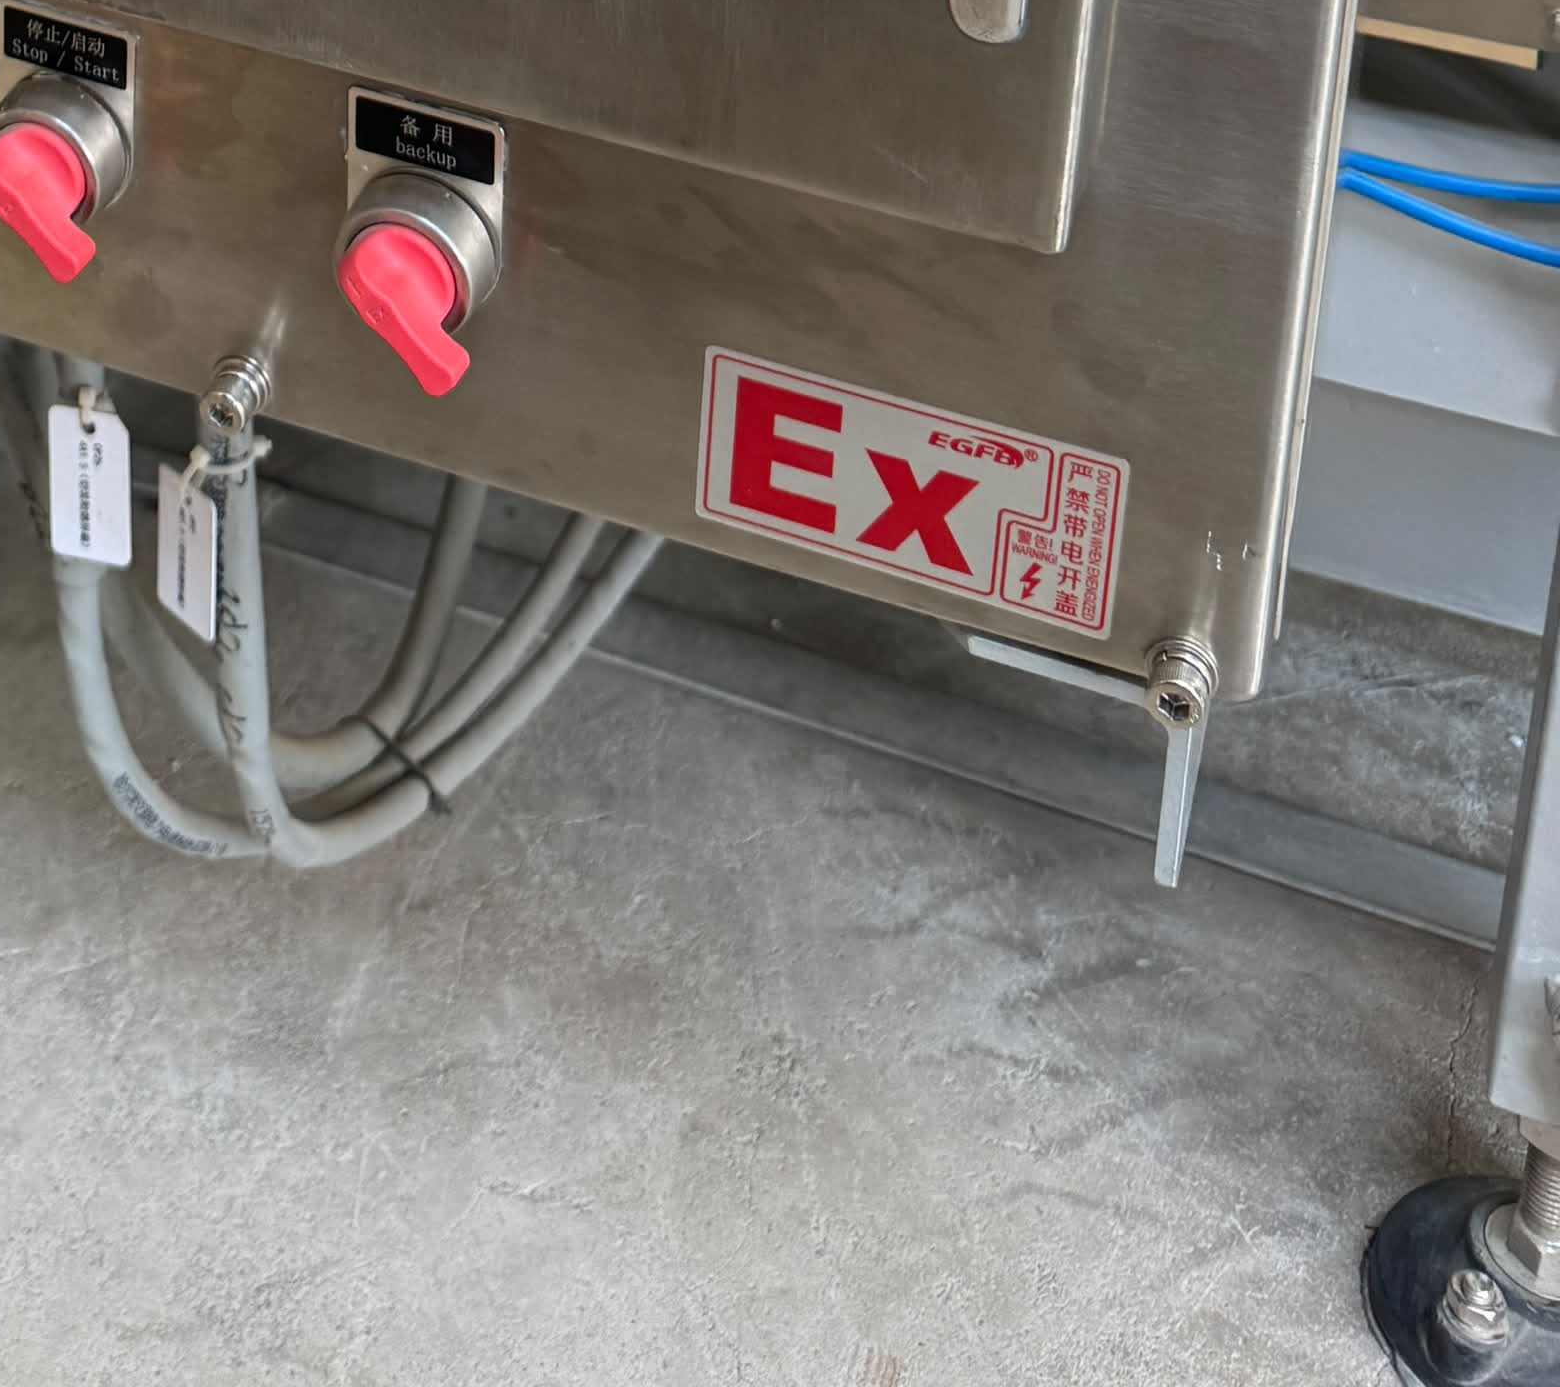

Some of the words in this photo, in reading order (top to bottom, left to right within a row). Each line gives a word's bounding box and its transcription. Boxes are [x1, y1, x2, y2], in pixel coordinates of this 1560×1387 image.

[27, 17, 105, 58] 停止/启动
[11, 38, 49, 65] Stop
[73, 57, 120, 82] Start
[395, 134, 457, 170] backup
[729, 375, 980, 577] Ex
[1096, 469, 1112, 485] DO
[1053, 461, 1093, 617] 严禁带电开盖
